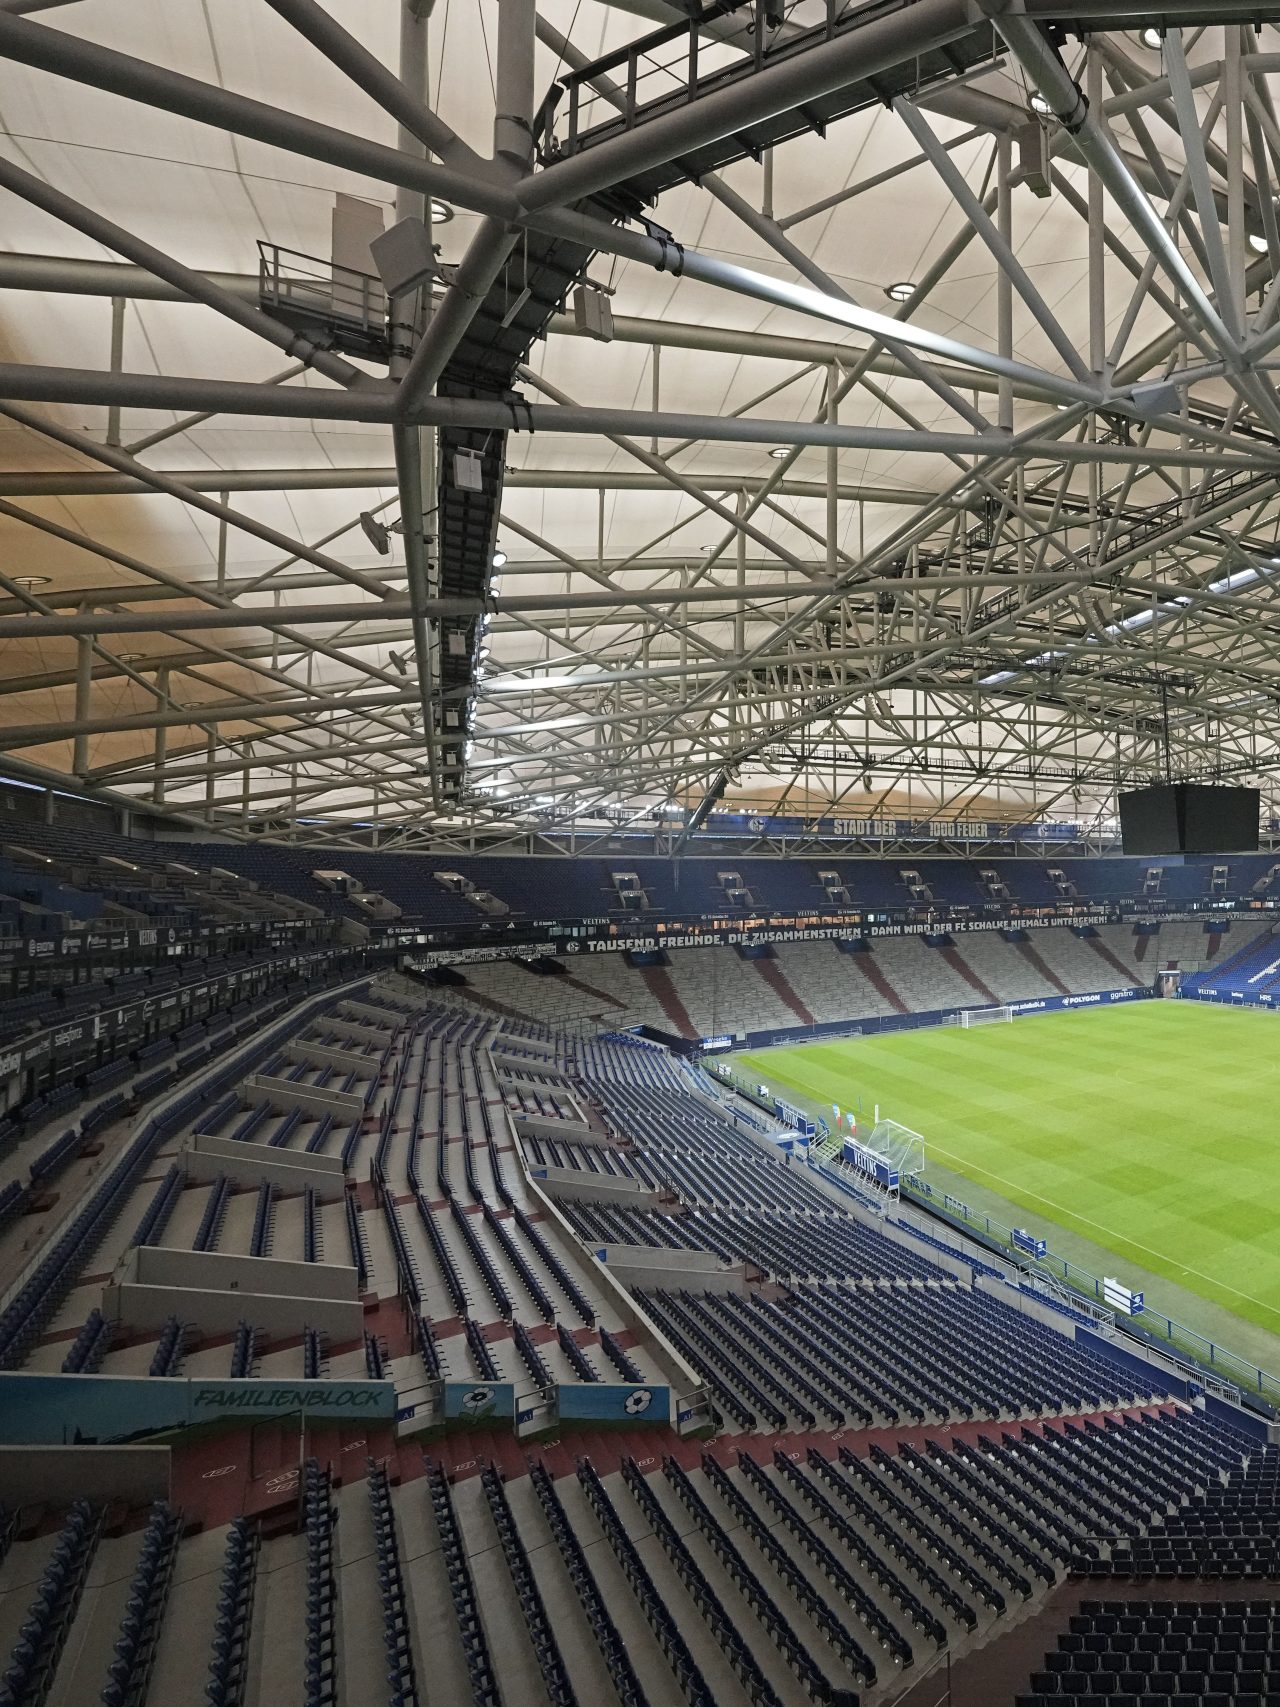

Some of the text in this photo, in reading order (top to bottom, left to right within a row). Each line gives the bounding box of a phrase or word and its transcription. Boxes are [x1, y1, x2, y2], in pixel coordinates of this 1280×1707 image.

[834, 819, 896, 836] STADT DER
[929, 822, 988, 838] 1000 FEUER
[582, 917, 611, 925] VELTINS
[587, 938, 655, 952] TAUSEND
[659, 934, 725, 948] FREUNDE,
[728, 933, 748, 944] DIE
[752, 927, 861, 942] ZUSAMMENSTEHEN
[871, 925, 901, 936] DANN
[904, 924, 930, 934] WIRD
[933, 923, 952, 932] DER
[955, 922, 966, 931] FC
[968, 920, 1008, 931] SCHALKE
[1011, 918, 1048, 929] NIEMALS
[1050, 915, 1107, 927] UNTERGEHEN!
[1197, 988, 1217, 996] VELTINS
[1259, 994, 1272, 1002] HRS
[1069, 994, 1100, 1004] POLYGON
[782, 1106, 799, 1128] VELTINS
[853, 1149, 877, 1177] VELTINS
[194, 1389, 384, 1407] FAMILIENBLOCK
[402, 1410, 414, 1420] A1
[521, 1413, 533, 1423] A1
